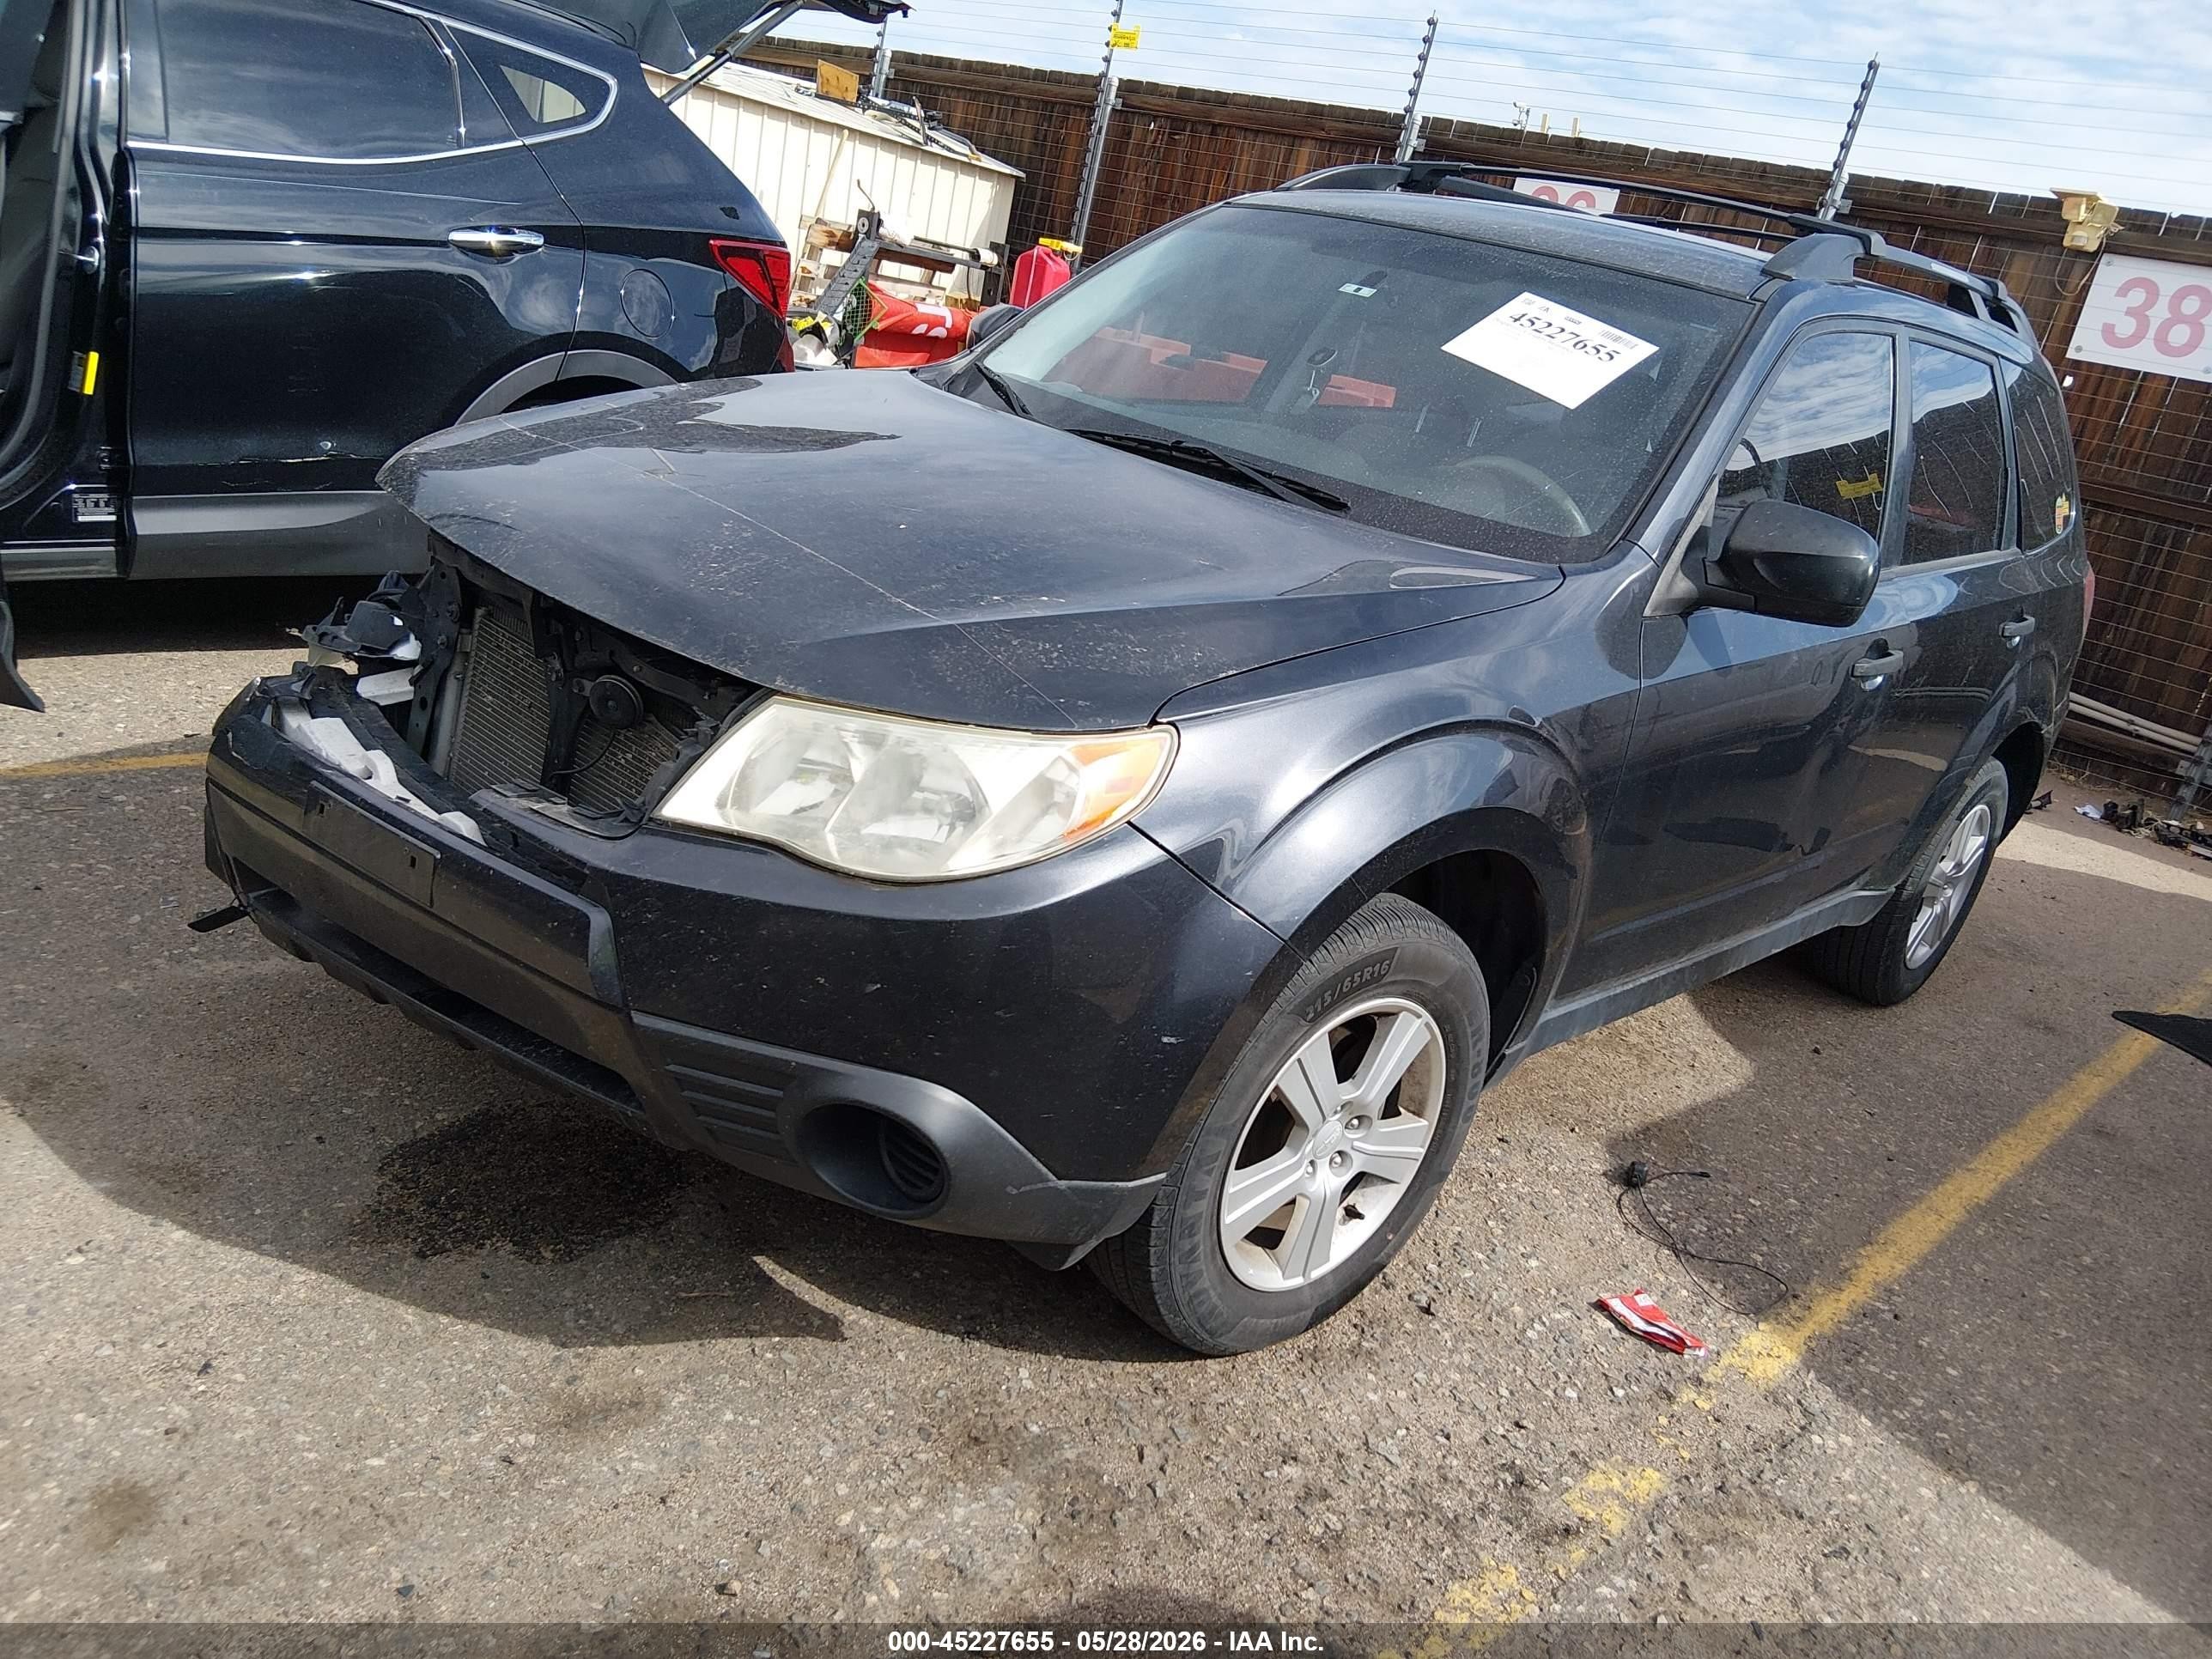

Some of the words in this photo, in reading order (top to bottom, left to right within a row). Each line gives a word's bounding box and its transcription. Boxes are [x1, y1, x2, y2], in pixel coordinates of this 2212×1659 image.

[1509, 312, 1622, 362] 45227655
[2101, 276, 2212, 358] 38
[1305, 959, 1390, 1022] 215/65R16
